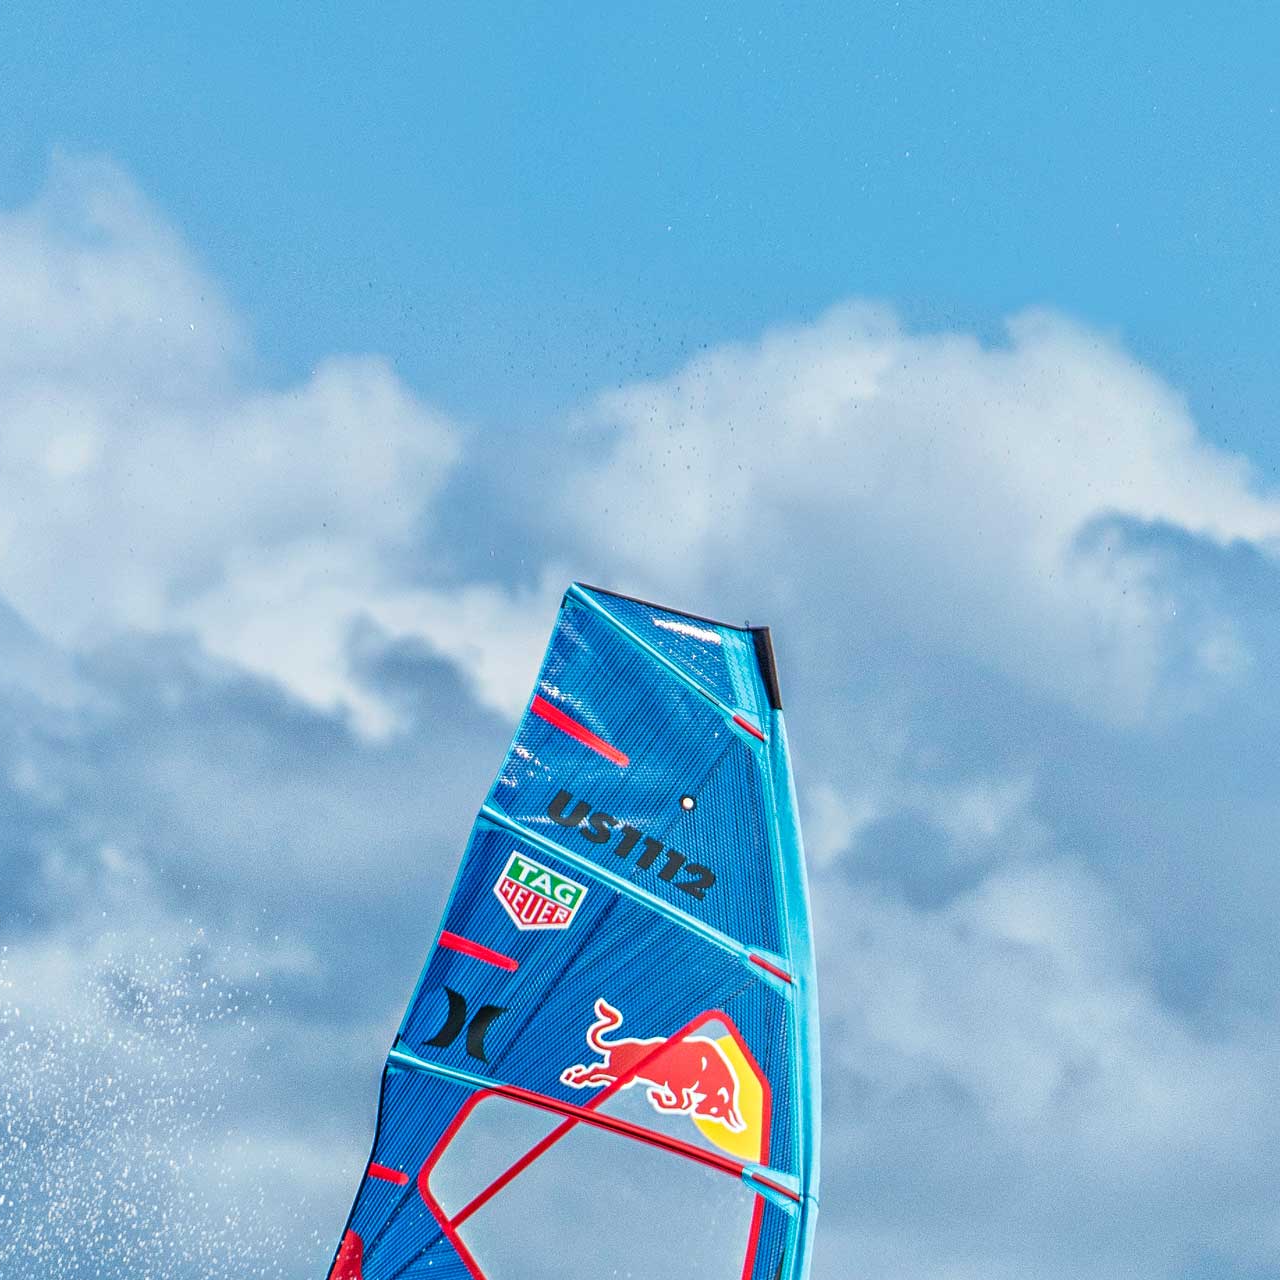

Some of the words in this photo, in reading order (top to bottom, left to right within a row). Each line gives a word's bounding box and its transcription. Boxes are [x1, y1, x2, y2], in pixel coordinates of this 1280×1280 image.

[547, 789, 716, 901] US1112
[501, 880, 570, 923] HEUER
[517, 859, 577, 906] TAG
